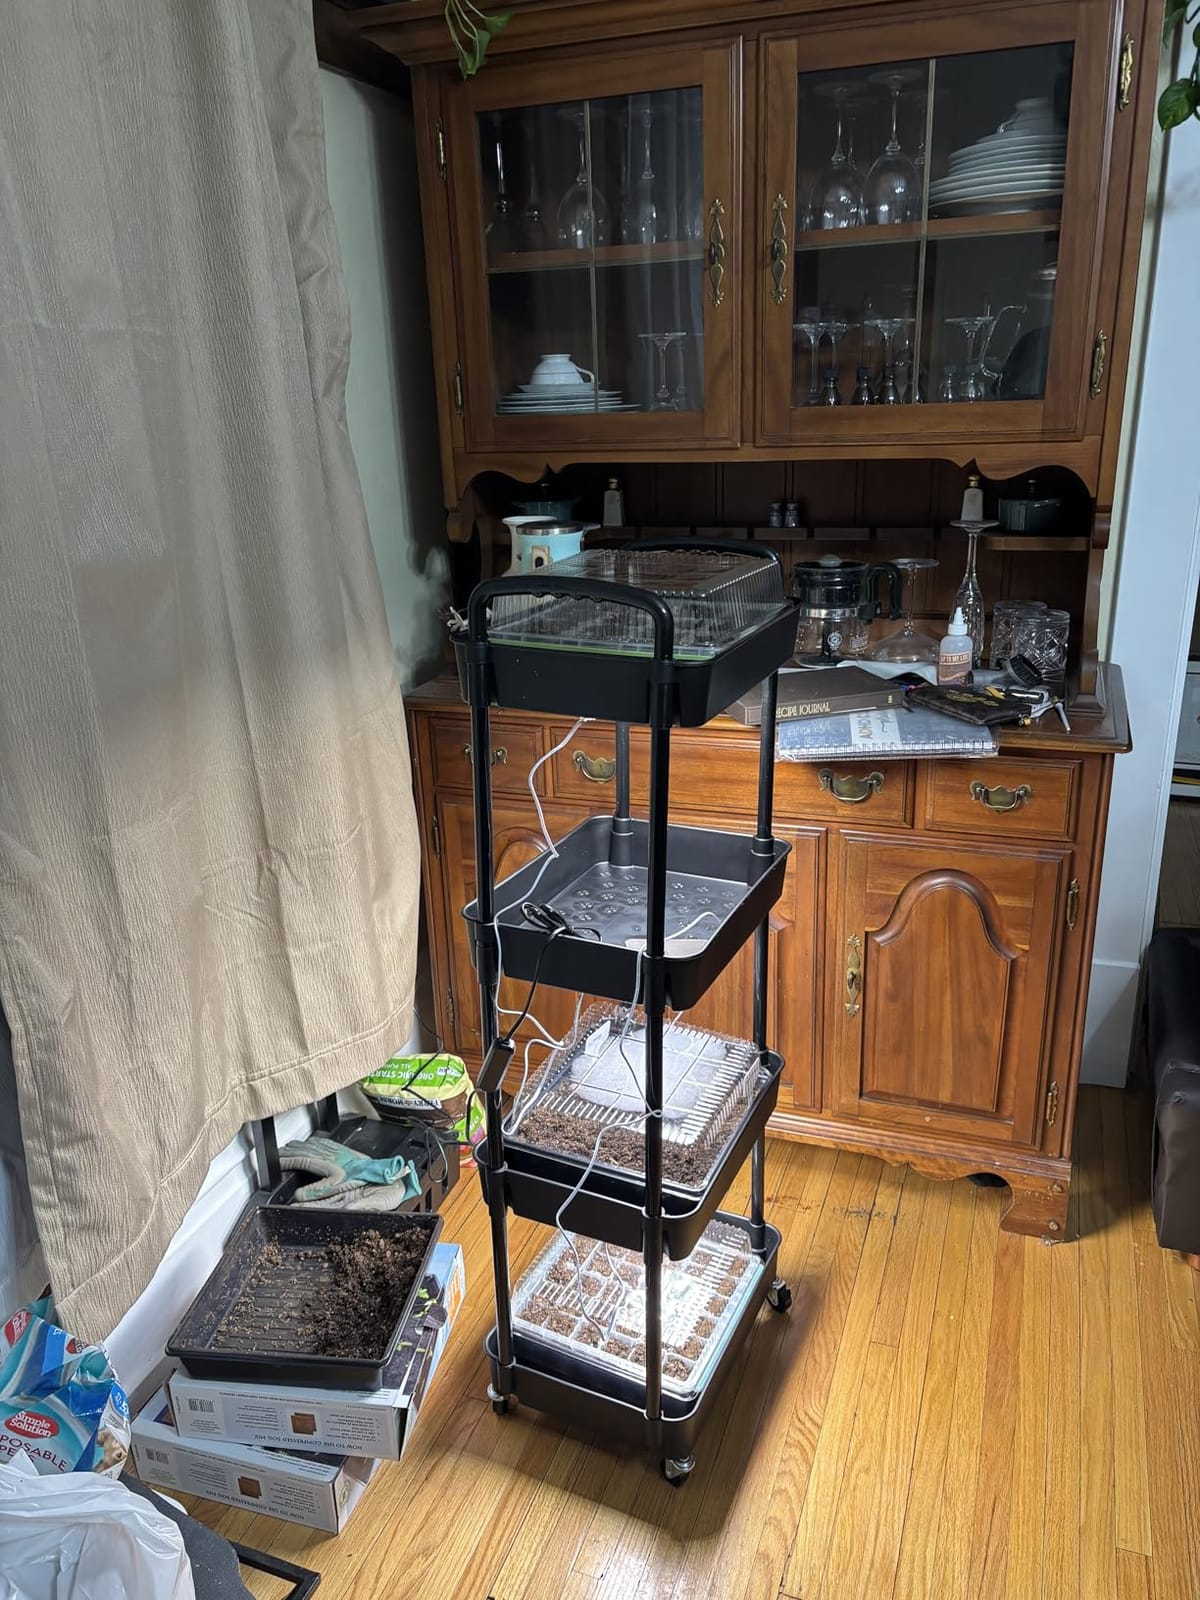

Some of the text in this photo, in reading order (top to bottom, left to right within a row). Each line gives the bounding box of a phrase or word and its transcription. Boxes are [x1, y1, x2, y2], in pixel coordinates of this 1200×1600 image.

[776, 702, 830, 718] ECIPE JOURNAL
[396, 1071, 434, 1080] ORGNIC
[10, 1418, 51, 1437] Solution
[15, 1411, 50, 1428] Simple
[283, 1438, 322, 1446] COMPRESSED
